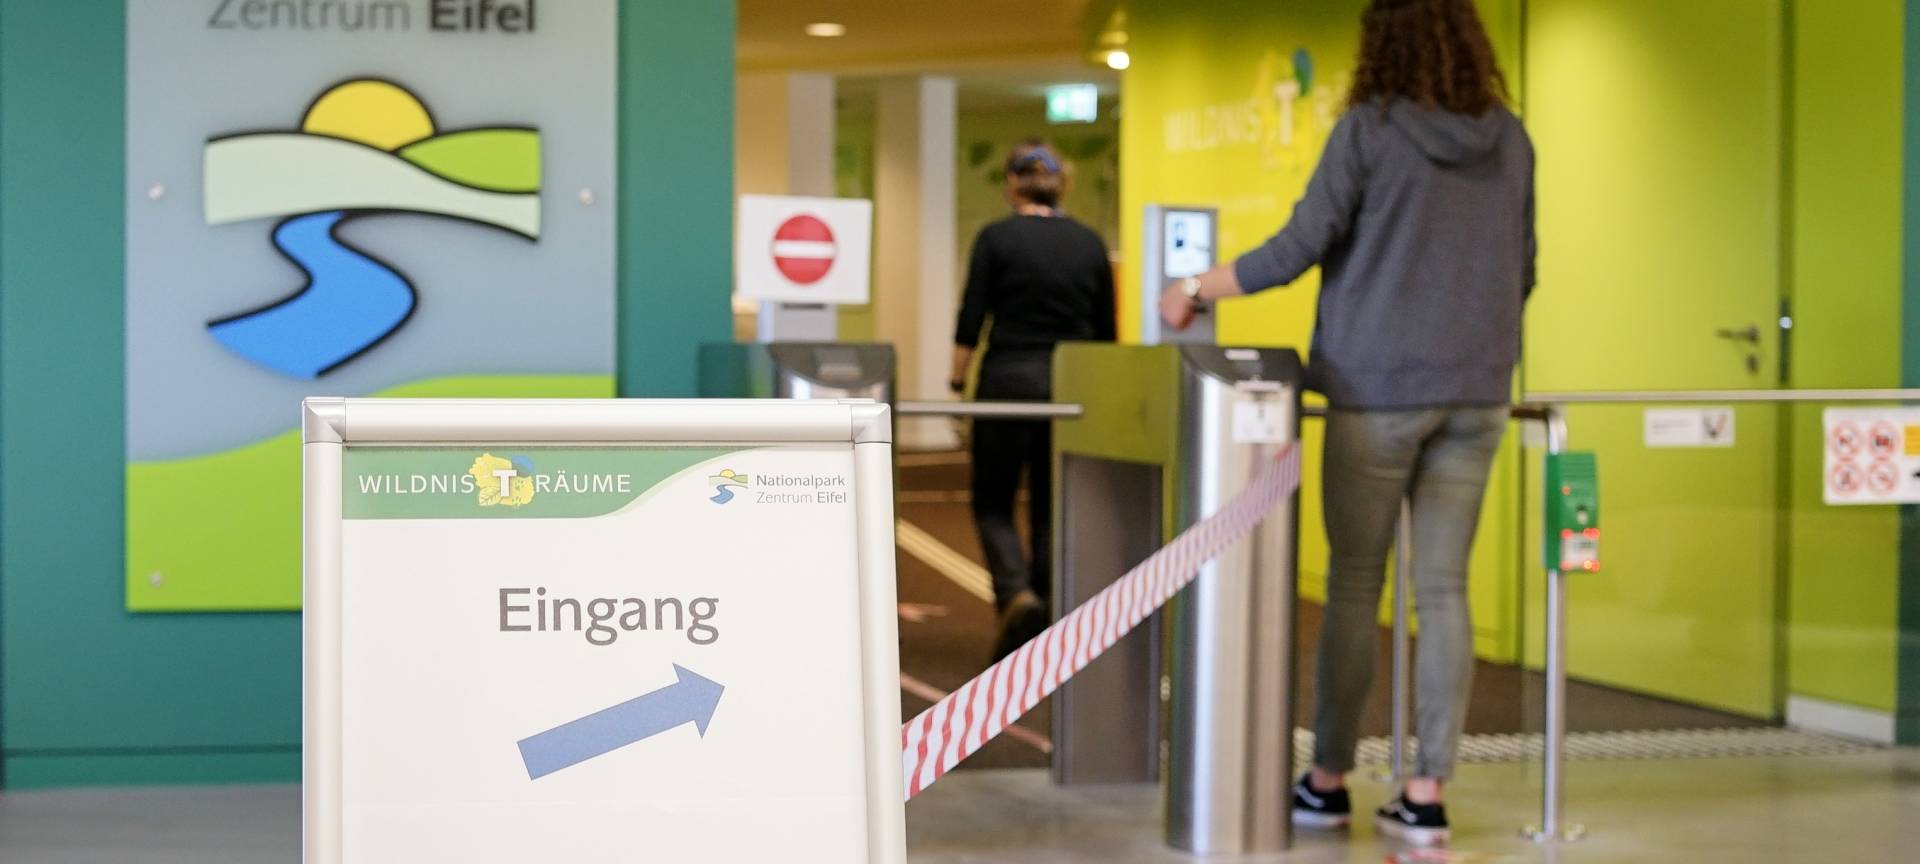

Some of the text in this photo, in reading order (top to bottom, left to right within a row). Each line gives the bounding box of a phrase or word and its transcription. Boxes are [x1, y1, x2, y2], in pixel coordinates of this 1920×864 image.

[206, 0, 536, 31] Zentrum Eifel
[756, 474, 846, 489] Nationalpark
[756, 491, 847, 504] Zentrum Eifel
[499, 586, 719, 646] Eingang
